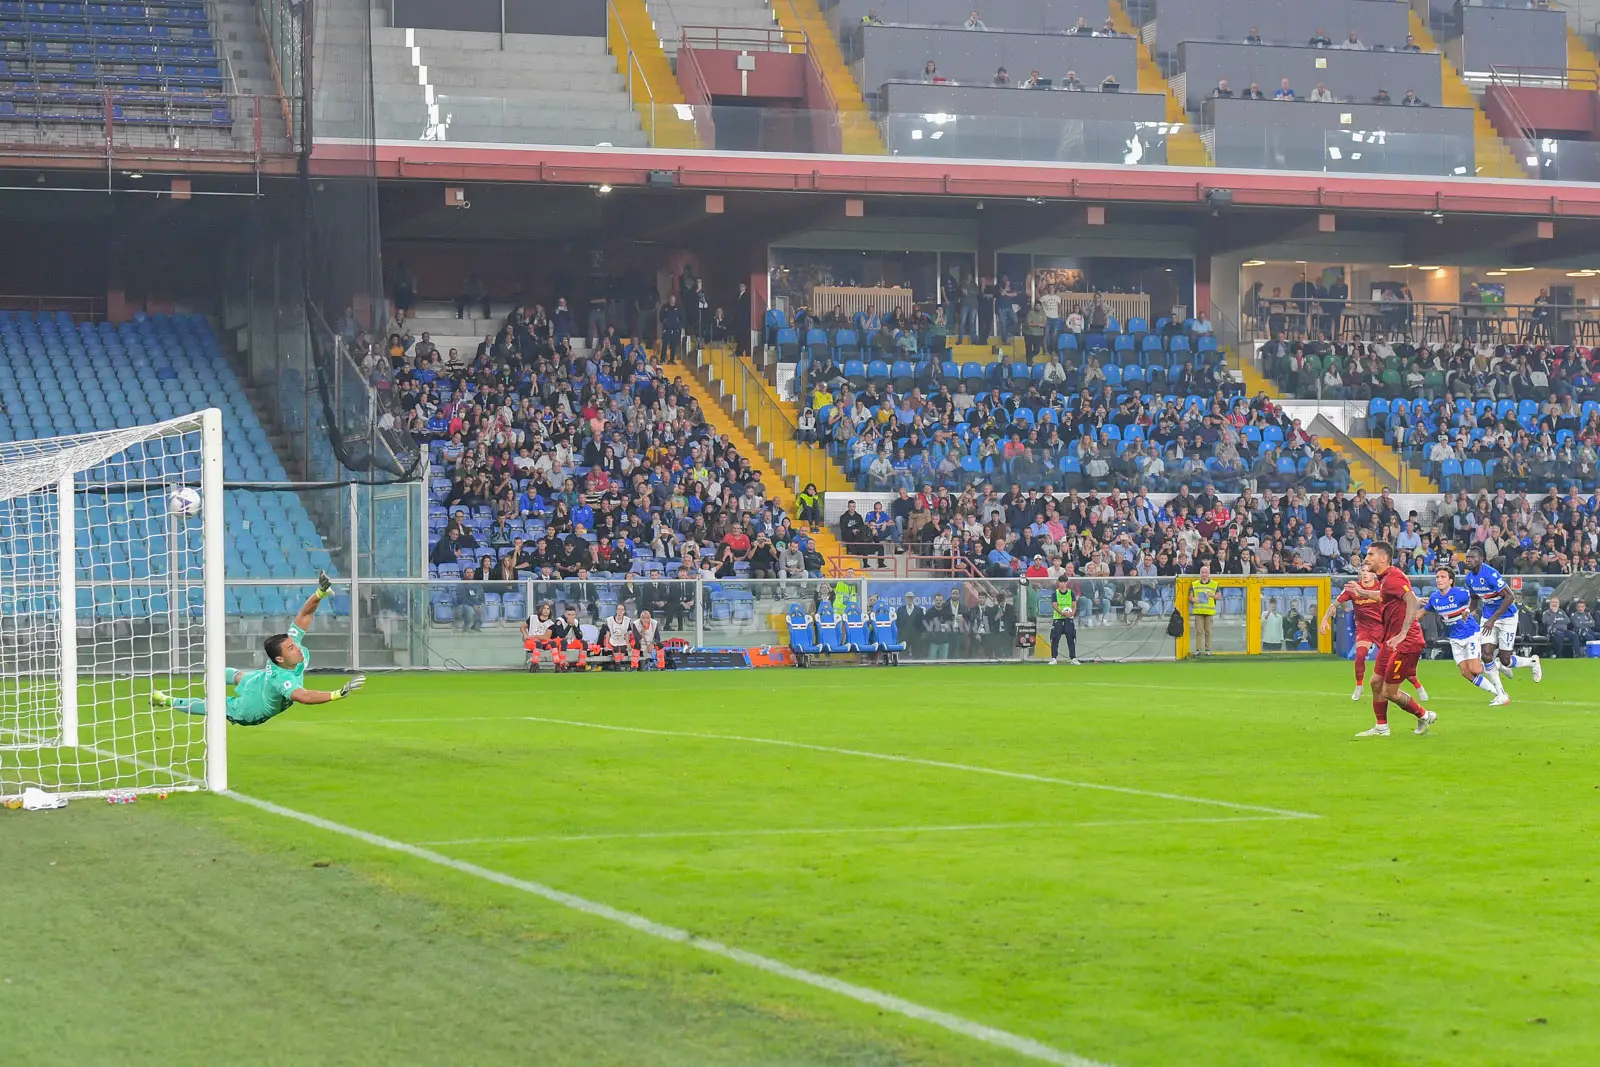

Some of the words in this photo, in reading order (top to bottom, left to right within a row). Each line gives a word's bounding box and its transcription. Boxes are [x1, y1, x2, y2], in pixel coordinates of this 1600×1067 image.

[1506, 632, 1515, 642] 15
[1470, 642, 1475, 650] 3
[1394, 660, 1403, 673] 7
